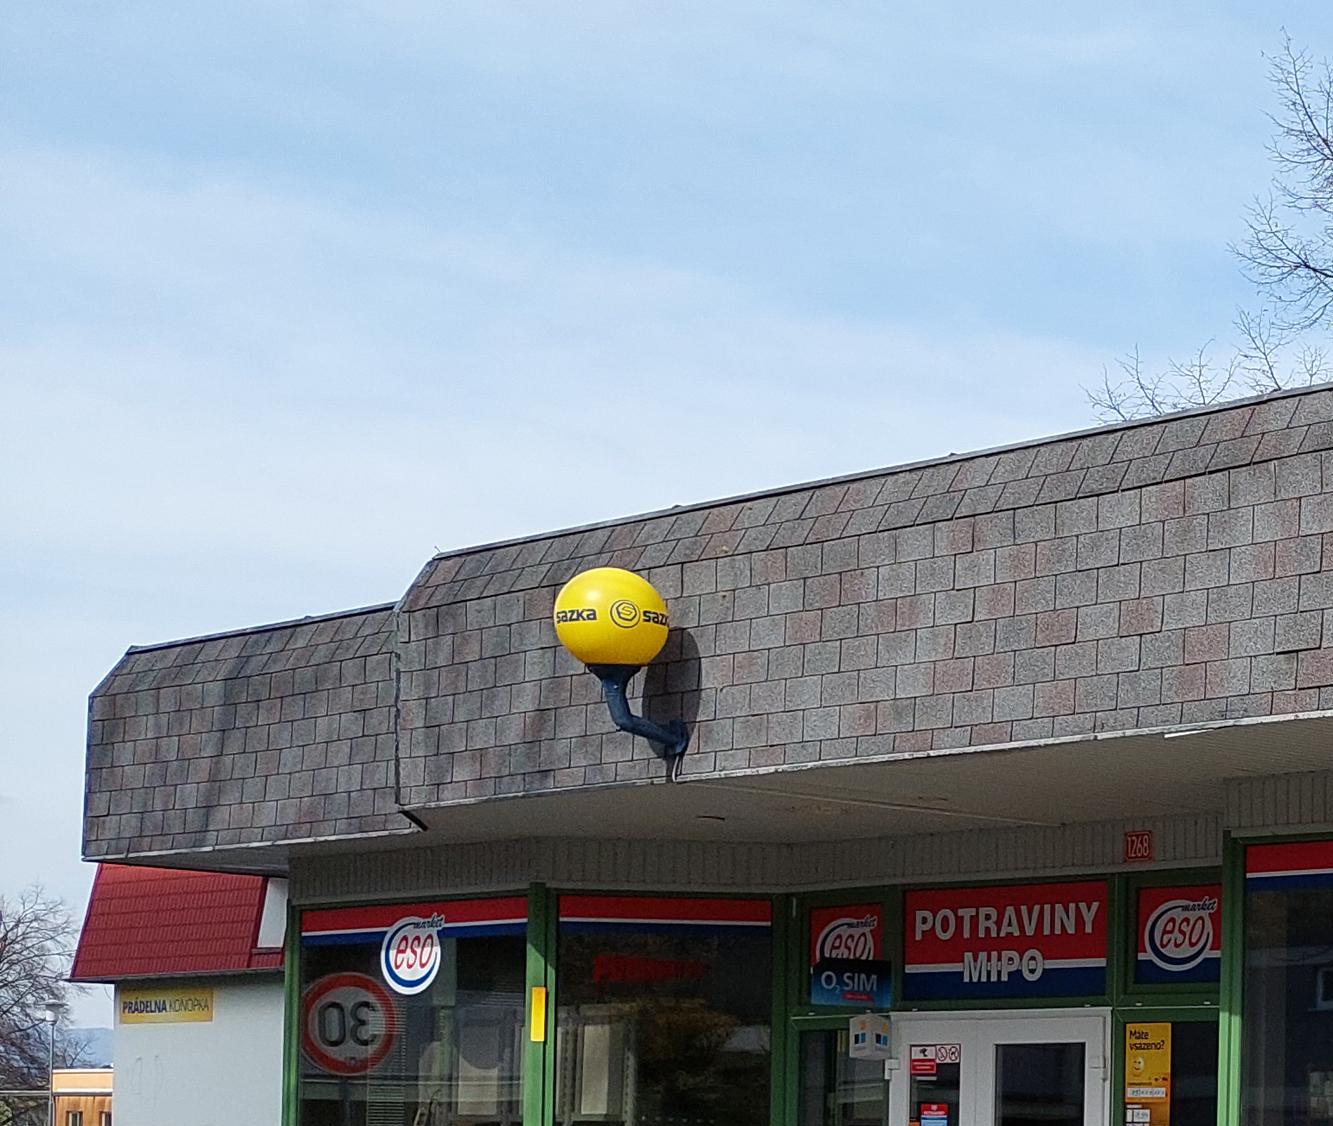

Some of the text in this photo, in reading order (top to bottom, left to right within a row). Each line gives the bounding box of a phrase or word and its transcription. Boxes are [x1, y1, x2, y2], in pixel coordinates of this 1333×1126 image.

[643, 610, 669, 627] saz
[1127, 835, 1149, 857] 1268
[1181, 897, 1217, 912] market
[915, 902, 1100, 940] POTRAVINY
[1160, 916, 1205, 949] eso
[394, 934, 434, 970] eso
[831, 933, 867, 960] eso
[963, 949, 1044, 983] MIPO
[843, 972, 877, 992] SIM
[122, 998, 167, 1014] PRÁDELNA
